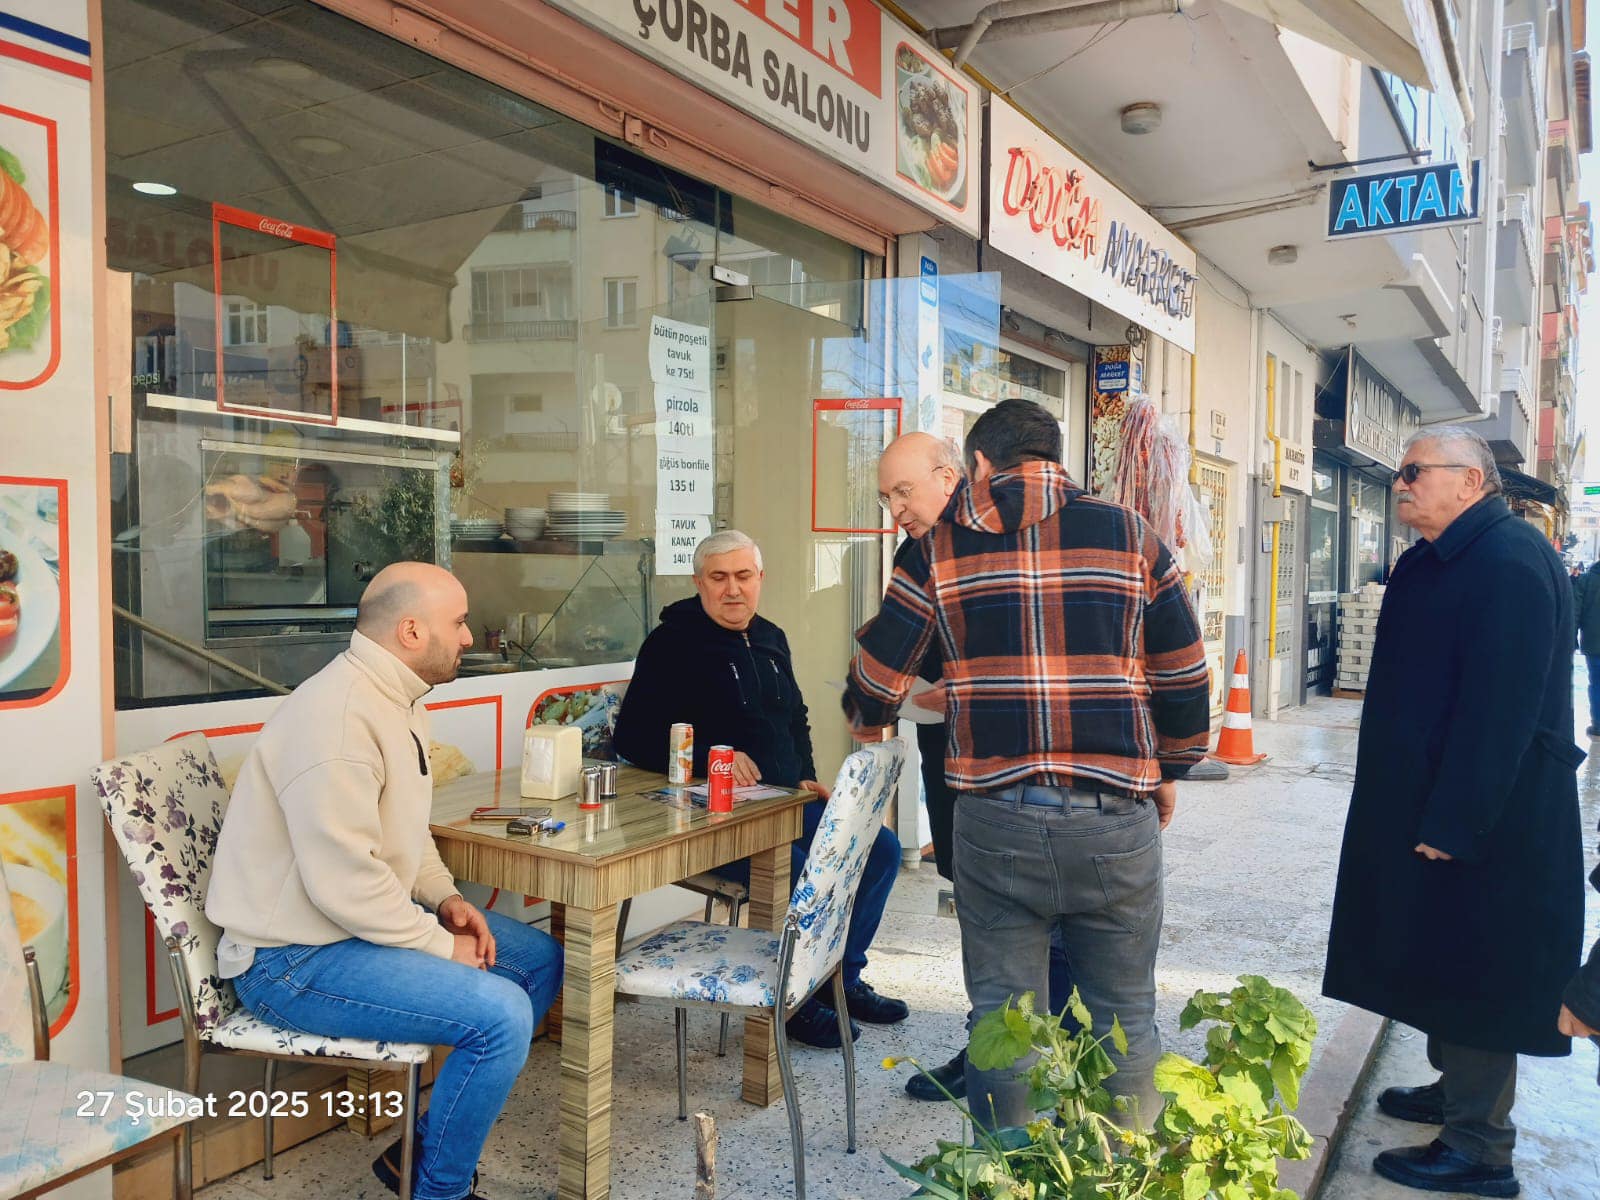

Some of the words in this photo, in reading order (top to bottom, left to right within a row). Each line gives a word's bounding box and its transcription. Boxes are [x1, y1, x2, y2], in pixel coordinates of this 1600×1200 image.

[633, 0, 753, 88] ÇORBA
[762, 49, 870, 153] SALONU
[1334, 169, 1468, 231] AKTAR
[653, 323, 678, 340] bütün
[667, 347, 692, 361] tavuk
[677, 367, 694, 380] 75tl
[666, 395, 699, 413] pirzola
[668, 420, 694, 437] 140tl
[680, 458, 710, 471] bonfile
[670, 479, 687, 492] 135
[689, 479, 695, 493] tl
[671, 519, 696, 530] TAVUK
[671, 536, 696, 547] KANAT
[673, 553, 687, 564] 140
